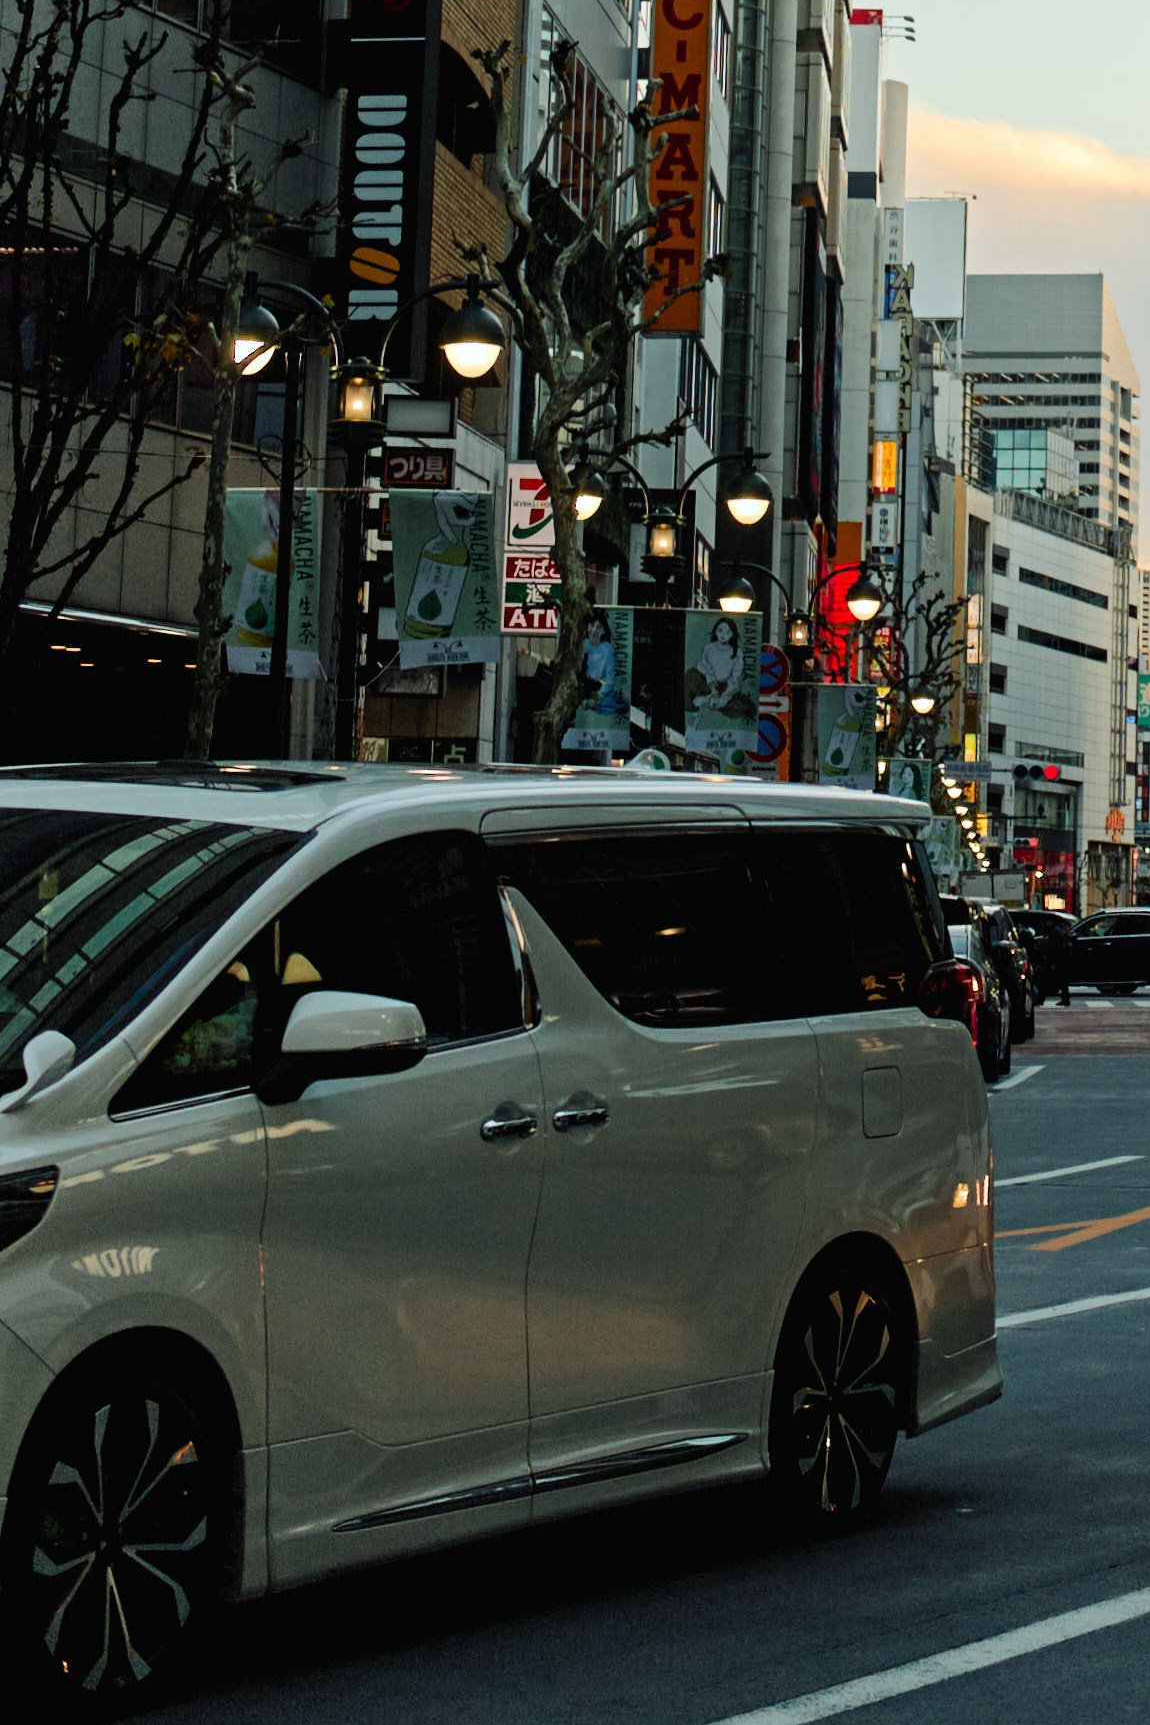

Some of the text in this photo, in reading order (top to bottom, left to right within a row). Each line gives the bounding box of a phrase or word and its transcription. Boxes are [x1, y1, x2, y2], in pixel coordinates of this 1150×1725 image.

[348, 94, 408, 321] DOUTOR
[389, 455, 444, 482] つり具
[469, 496, 497, 631] NAMACHA 生茶
[297, 597, 316, 645] 生茶
[613, 611, 629, 681] NAMACHA
[742, 617, 759, 681] NAMACHA
